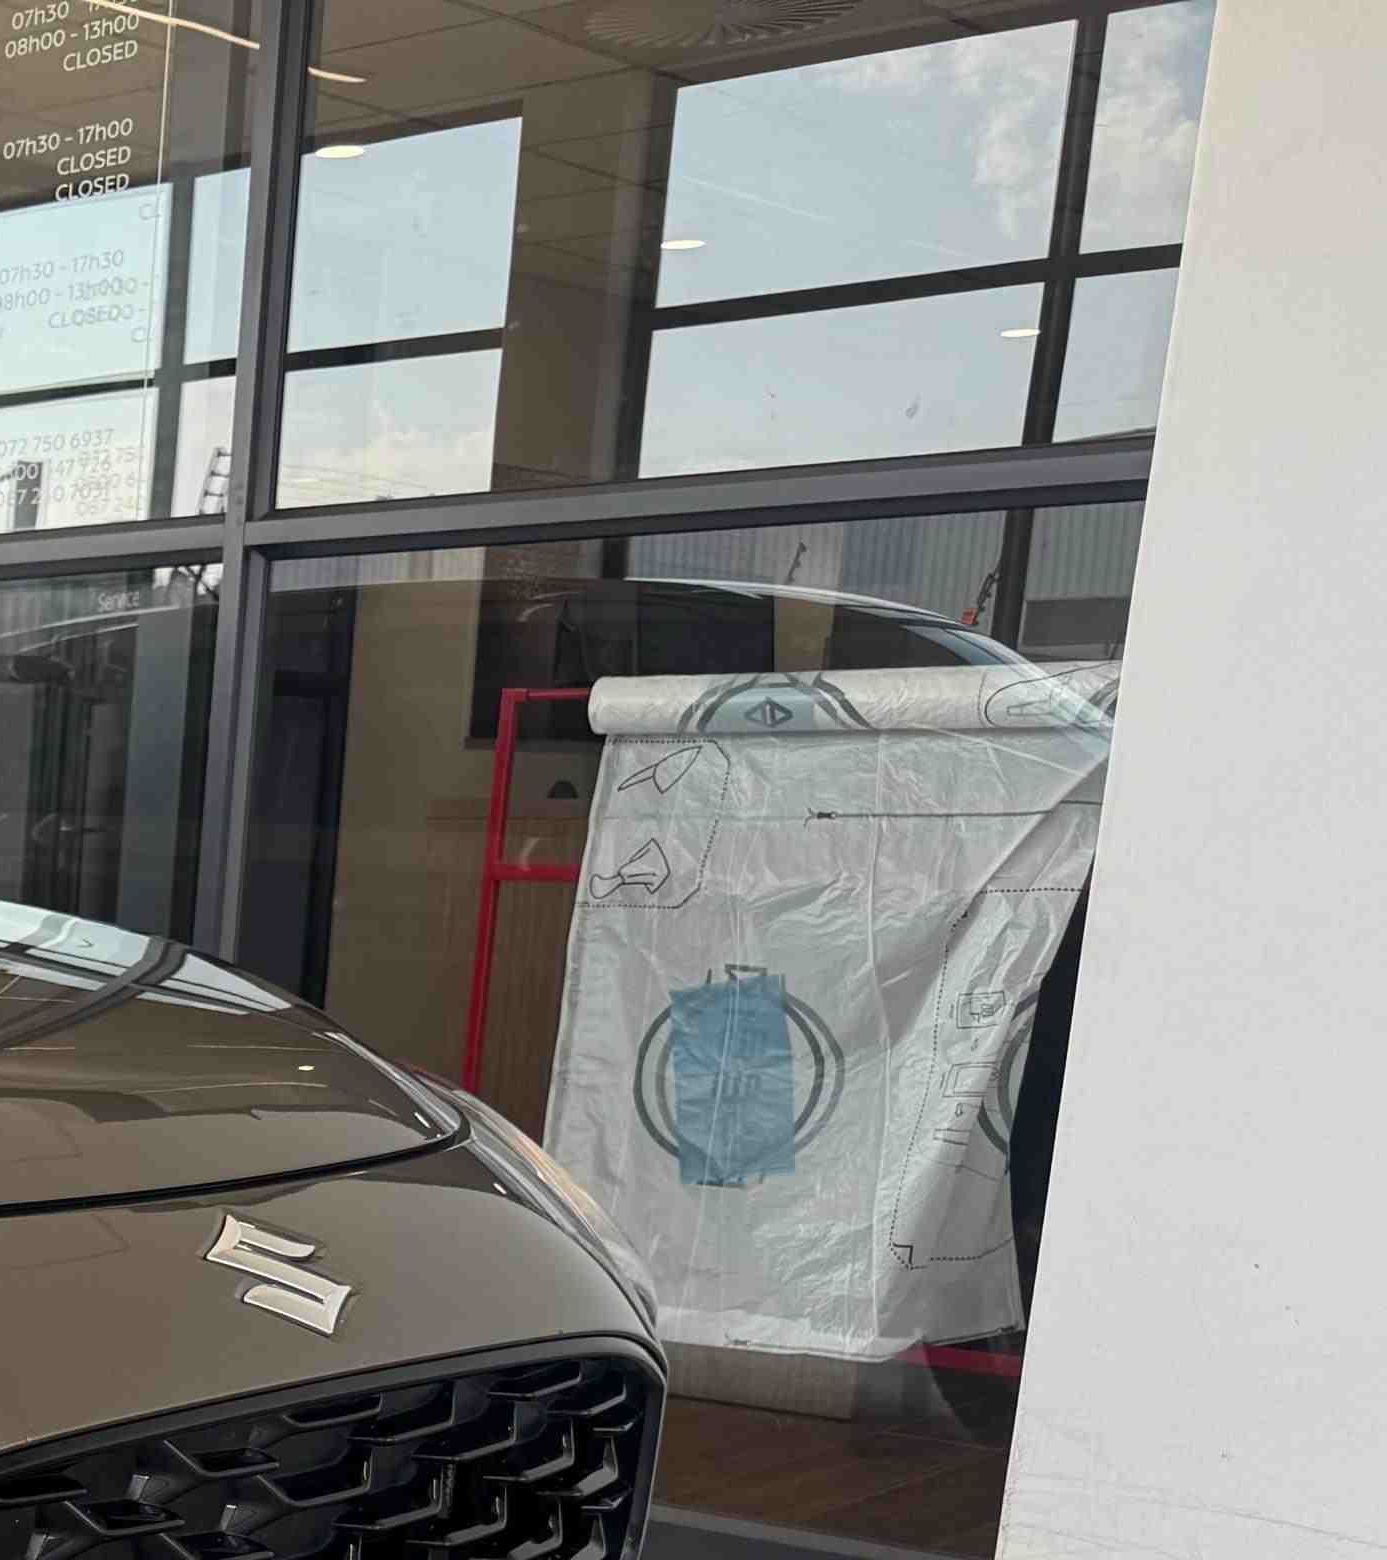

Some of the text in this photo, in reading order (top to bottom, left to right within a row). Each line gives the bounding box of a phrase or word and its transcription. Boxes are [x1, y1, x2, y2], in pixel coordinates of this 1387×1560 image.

[12, 1, 69, 30] 07h30
[5, 29, 66, 58] 08h00
[83, 14, 140, 41] 13h00
[63, 40, 138, 71] CLOSED
[3, 132, 60, 160] 07h30
[77, 118, 133, 145] 17h00
[57, 146, 132, 175] CLOSED
[55, 173, 130, 201] CLOSED
